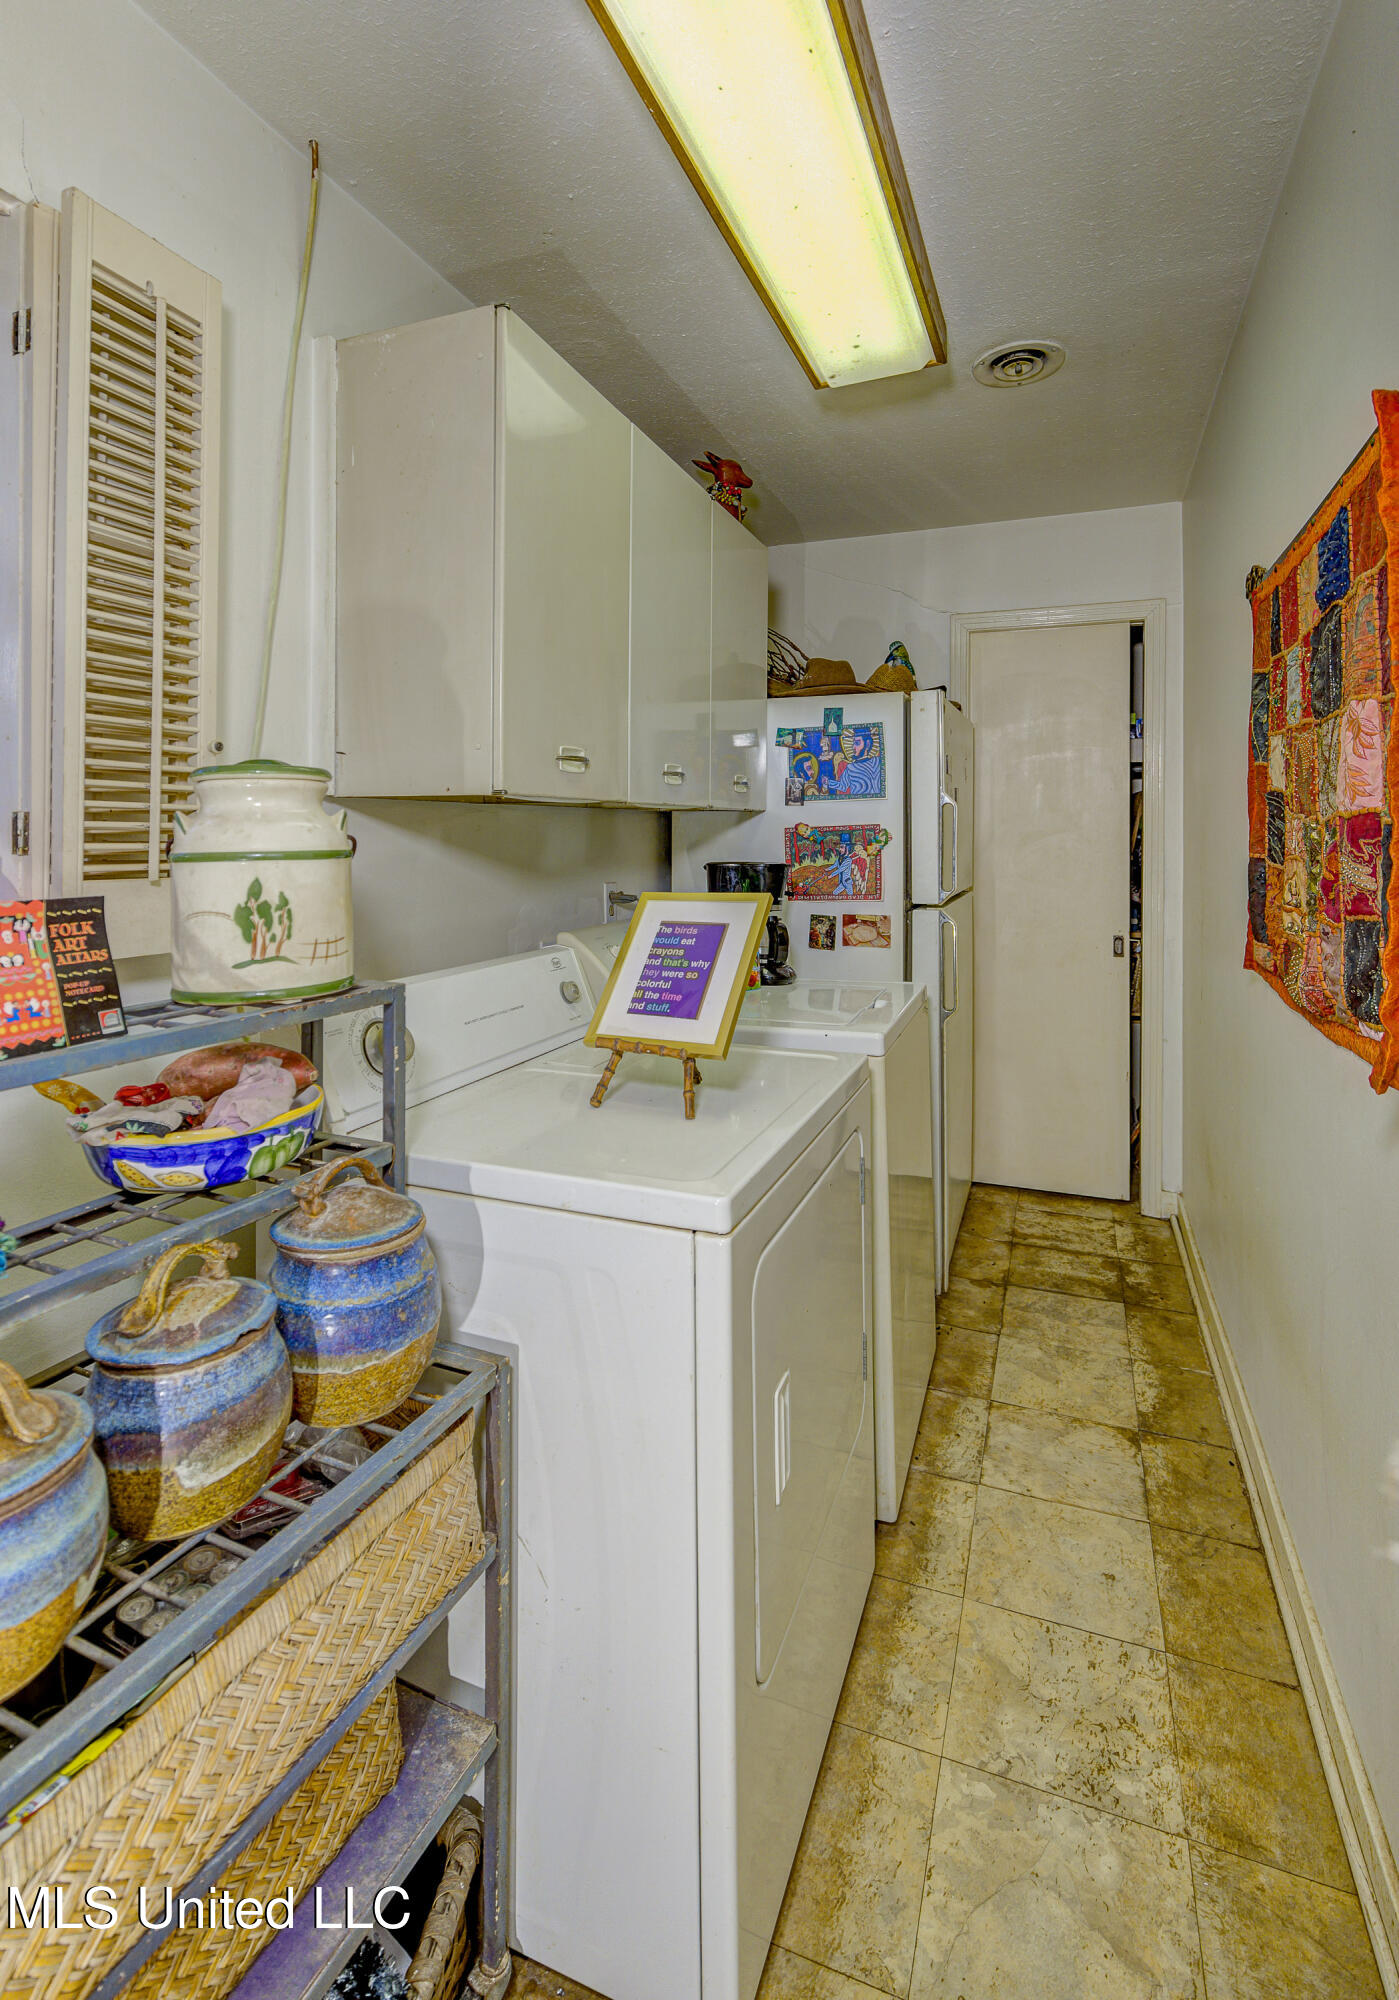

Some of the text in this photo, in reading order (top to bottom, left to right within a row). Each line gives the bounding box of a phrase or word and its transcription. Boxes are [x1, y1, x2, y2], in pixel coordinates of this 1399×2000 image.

[48, 921, 96, 938] FOLK
[658, 925, 698, 935] The birds
[53, 936, 88, 953] ART
[680, 937, 696, 945] eat
[649, 947, 685, 957] crayons
[56, 949, 108, 966] ALTARS
[662, 959, 689, 967] that's
[690, 960, 710, 970] why
[642, 968, 698, 979] hey were so
[637, 980, 671, 989] colorful
[644, 991, 659, 999] the
[661, 992, 682, 1001] time
[646, 1003, 670, 1012] stuff.
